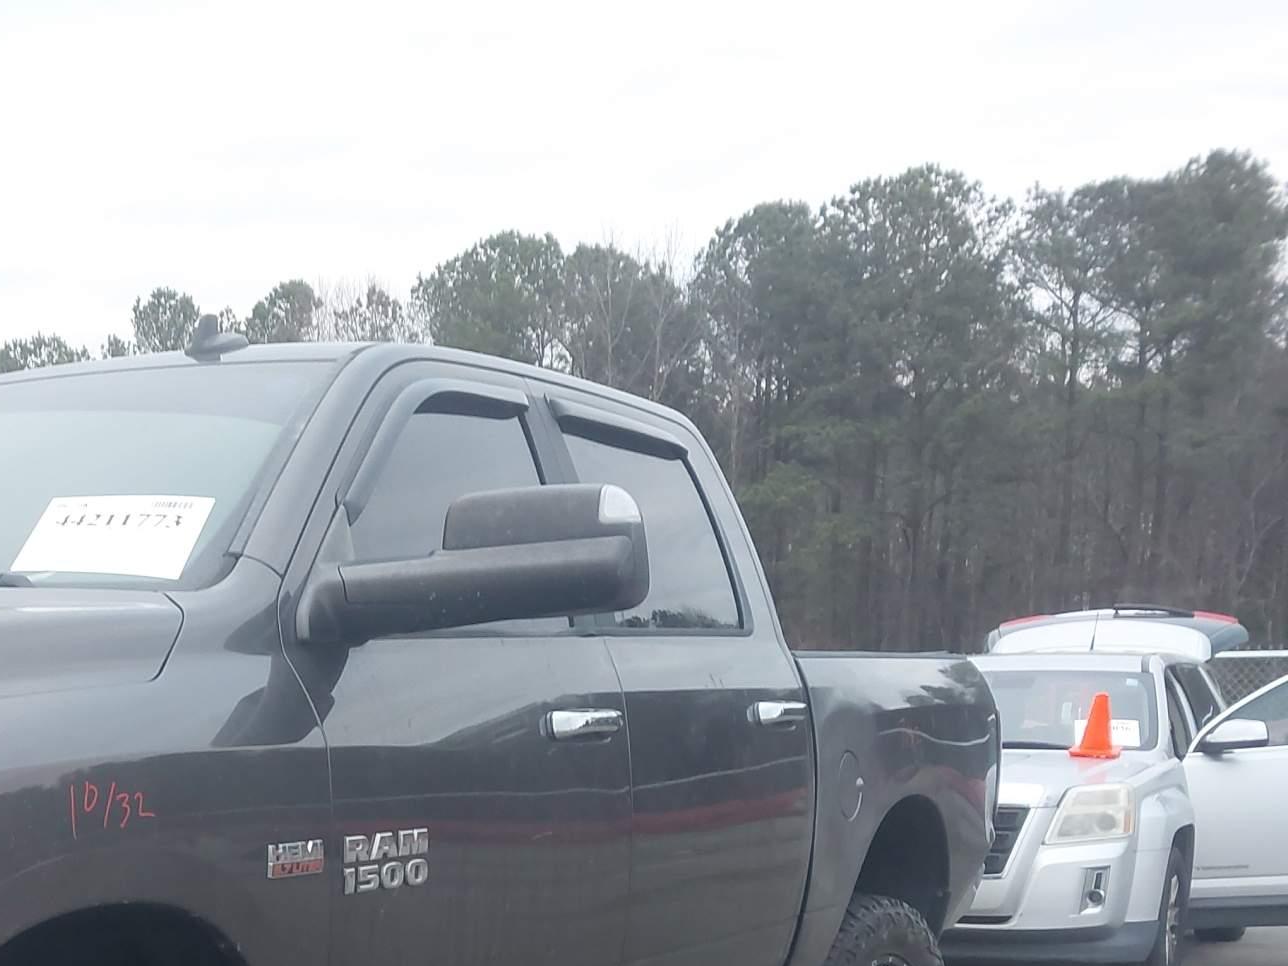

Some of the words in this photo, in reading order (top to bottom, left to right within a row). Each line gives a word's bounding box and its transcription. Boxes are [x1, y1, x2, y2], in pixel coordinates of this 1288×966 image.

[67, 781, 156, 840] 10/32
[268, 839, 324, 863] HEMI
[343, 827, 429, 864] RAM
[343, 858, 429, 896] 1500
